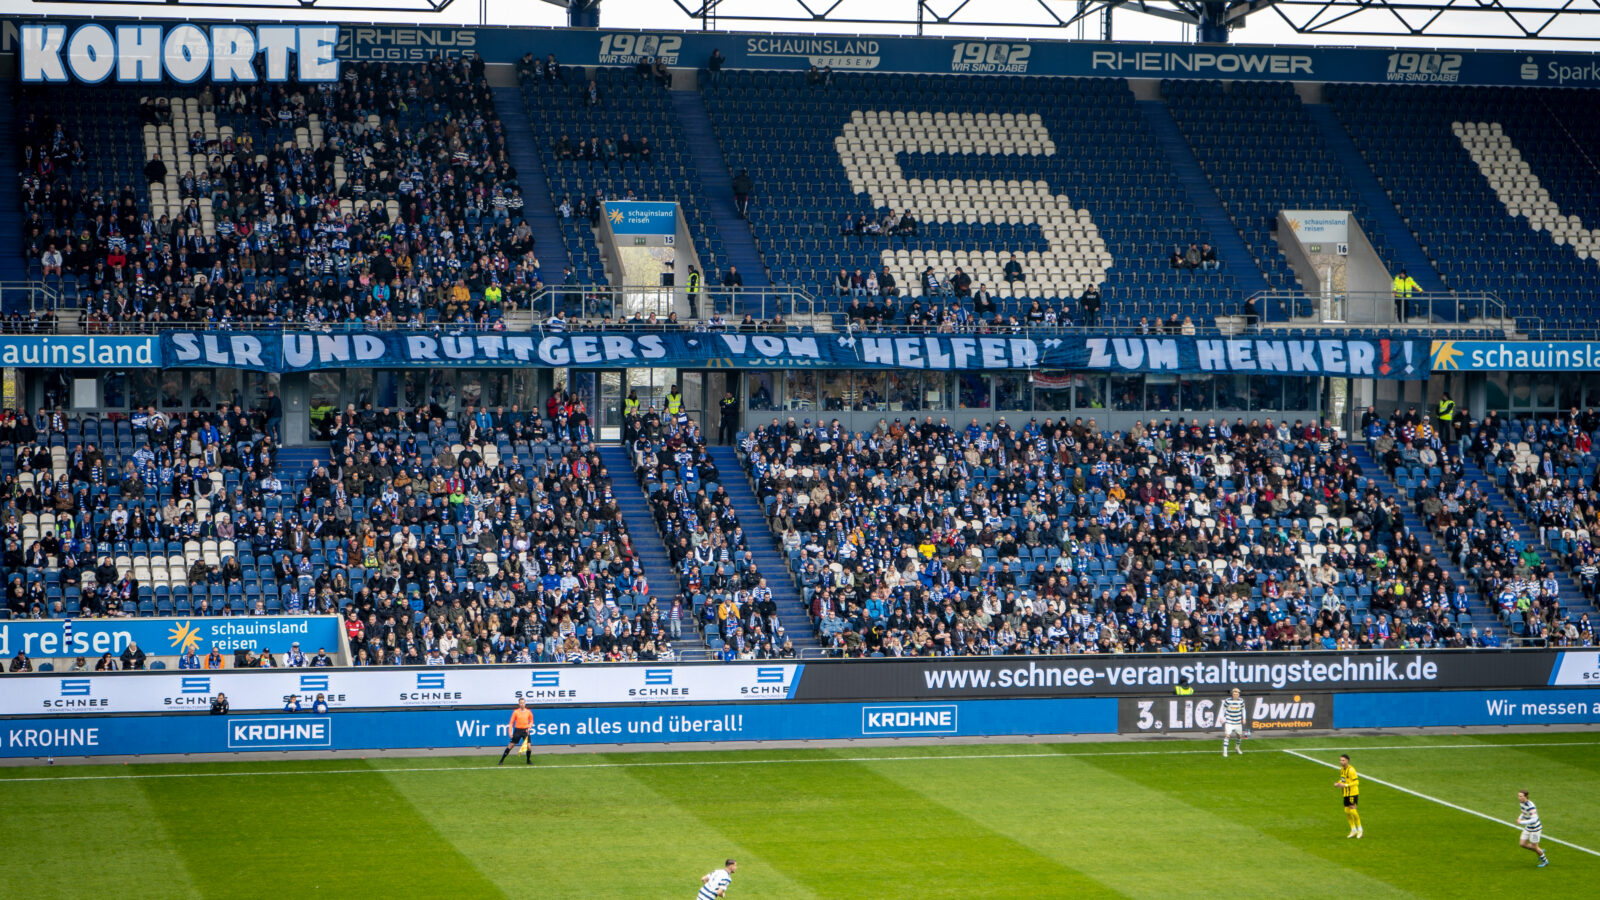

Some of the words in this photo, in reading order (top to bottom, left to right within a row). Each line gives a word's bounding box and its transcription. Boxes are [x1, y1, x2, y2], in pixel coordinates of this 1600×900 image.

[356, 28, 476, 46] RHENUS
[600, 34, 682, 56] 1902
[356, 47, 476, 60] LOGISTICS
[747, 38, 879, 55] SCHAUINSLAND
[952, 42, 1031, 65] 1902
[599, 54, 618, 64] WIR
[647, 55, 678, 65] DBEI
[817, 58, 872, 66] REISEN
[952, 62, 970, 71] WIR
[971, 63, 995, 72] SIND
[997, 63, 1028, 73] DABEI
[1092, 51, 1314, 74] RHEINPOWER
[1387, 53, 1462, 74] 1902
[1387, 72, 1404, 81] WIR
[1405, 73, 1428, 81] SIND
[1430, 73, 1459, 82] DABEI
[1547, 61, 1600, 84] Spark
[664, 236, 674, 244] 15
[1337, 244, 1347, 253] 16
[3, 338, 153, 364] auinsland
[172, 332, 264, 366] SLR
[282, 334, 386, 367] UND
[407, 331, 666, 365] RÜTTGERS
[721, 334, 820, 358] VOM
[1086, 338, 1180, 369] ZUM
[211, 621, 308, 635] schauinsland
[211, 637, 257, 649] reisen
[924, 655, 1438, 689] www.schnee-veranstaltungstechnik.de
[164, 696, 228, 705] SCHNE
[400, 692, 462, 700] SCHNEE
[515, 690, 577, 698] SCHNEE
[628, 688, 689, 696] SCHNEE
[43, 699, 109, 707] SCHNEE
[1252, 695, 1316, 720] bwin
[1486, 699, 1516, 716] Wir
[1522, 702, 1587, 716] messen
[868, 711, 952, 728] KROHNE
[1137, 701, 1163, 729] 3.
[234, 724, 325, 741] KROHNE
[456, 720, 490, 737] Wir
[496, 722, 571, 737] mssen
[576, 717, 621, 734] alles
[628, 716, 663, 733] und
[669, 714, 743, 732] überall!
[1252, 721, 1313, 730] Sportwetten
[10, 728, 99, 747] KROHNE
